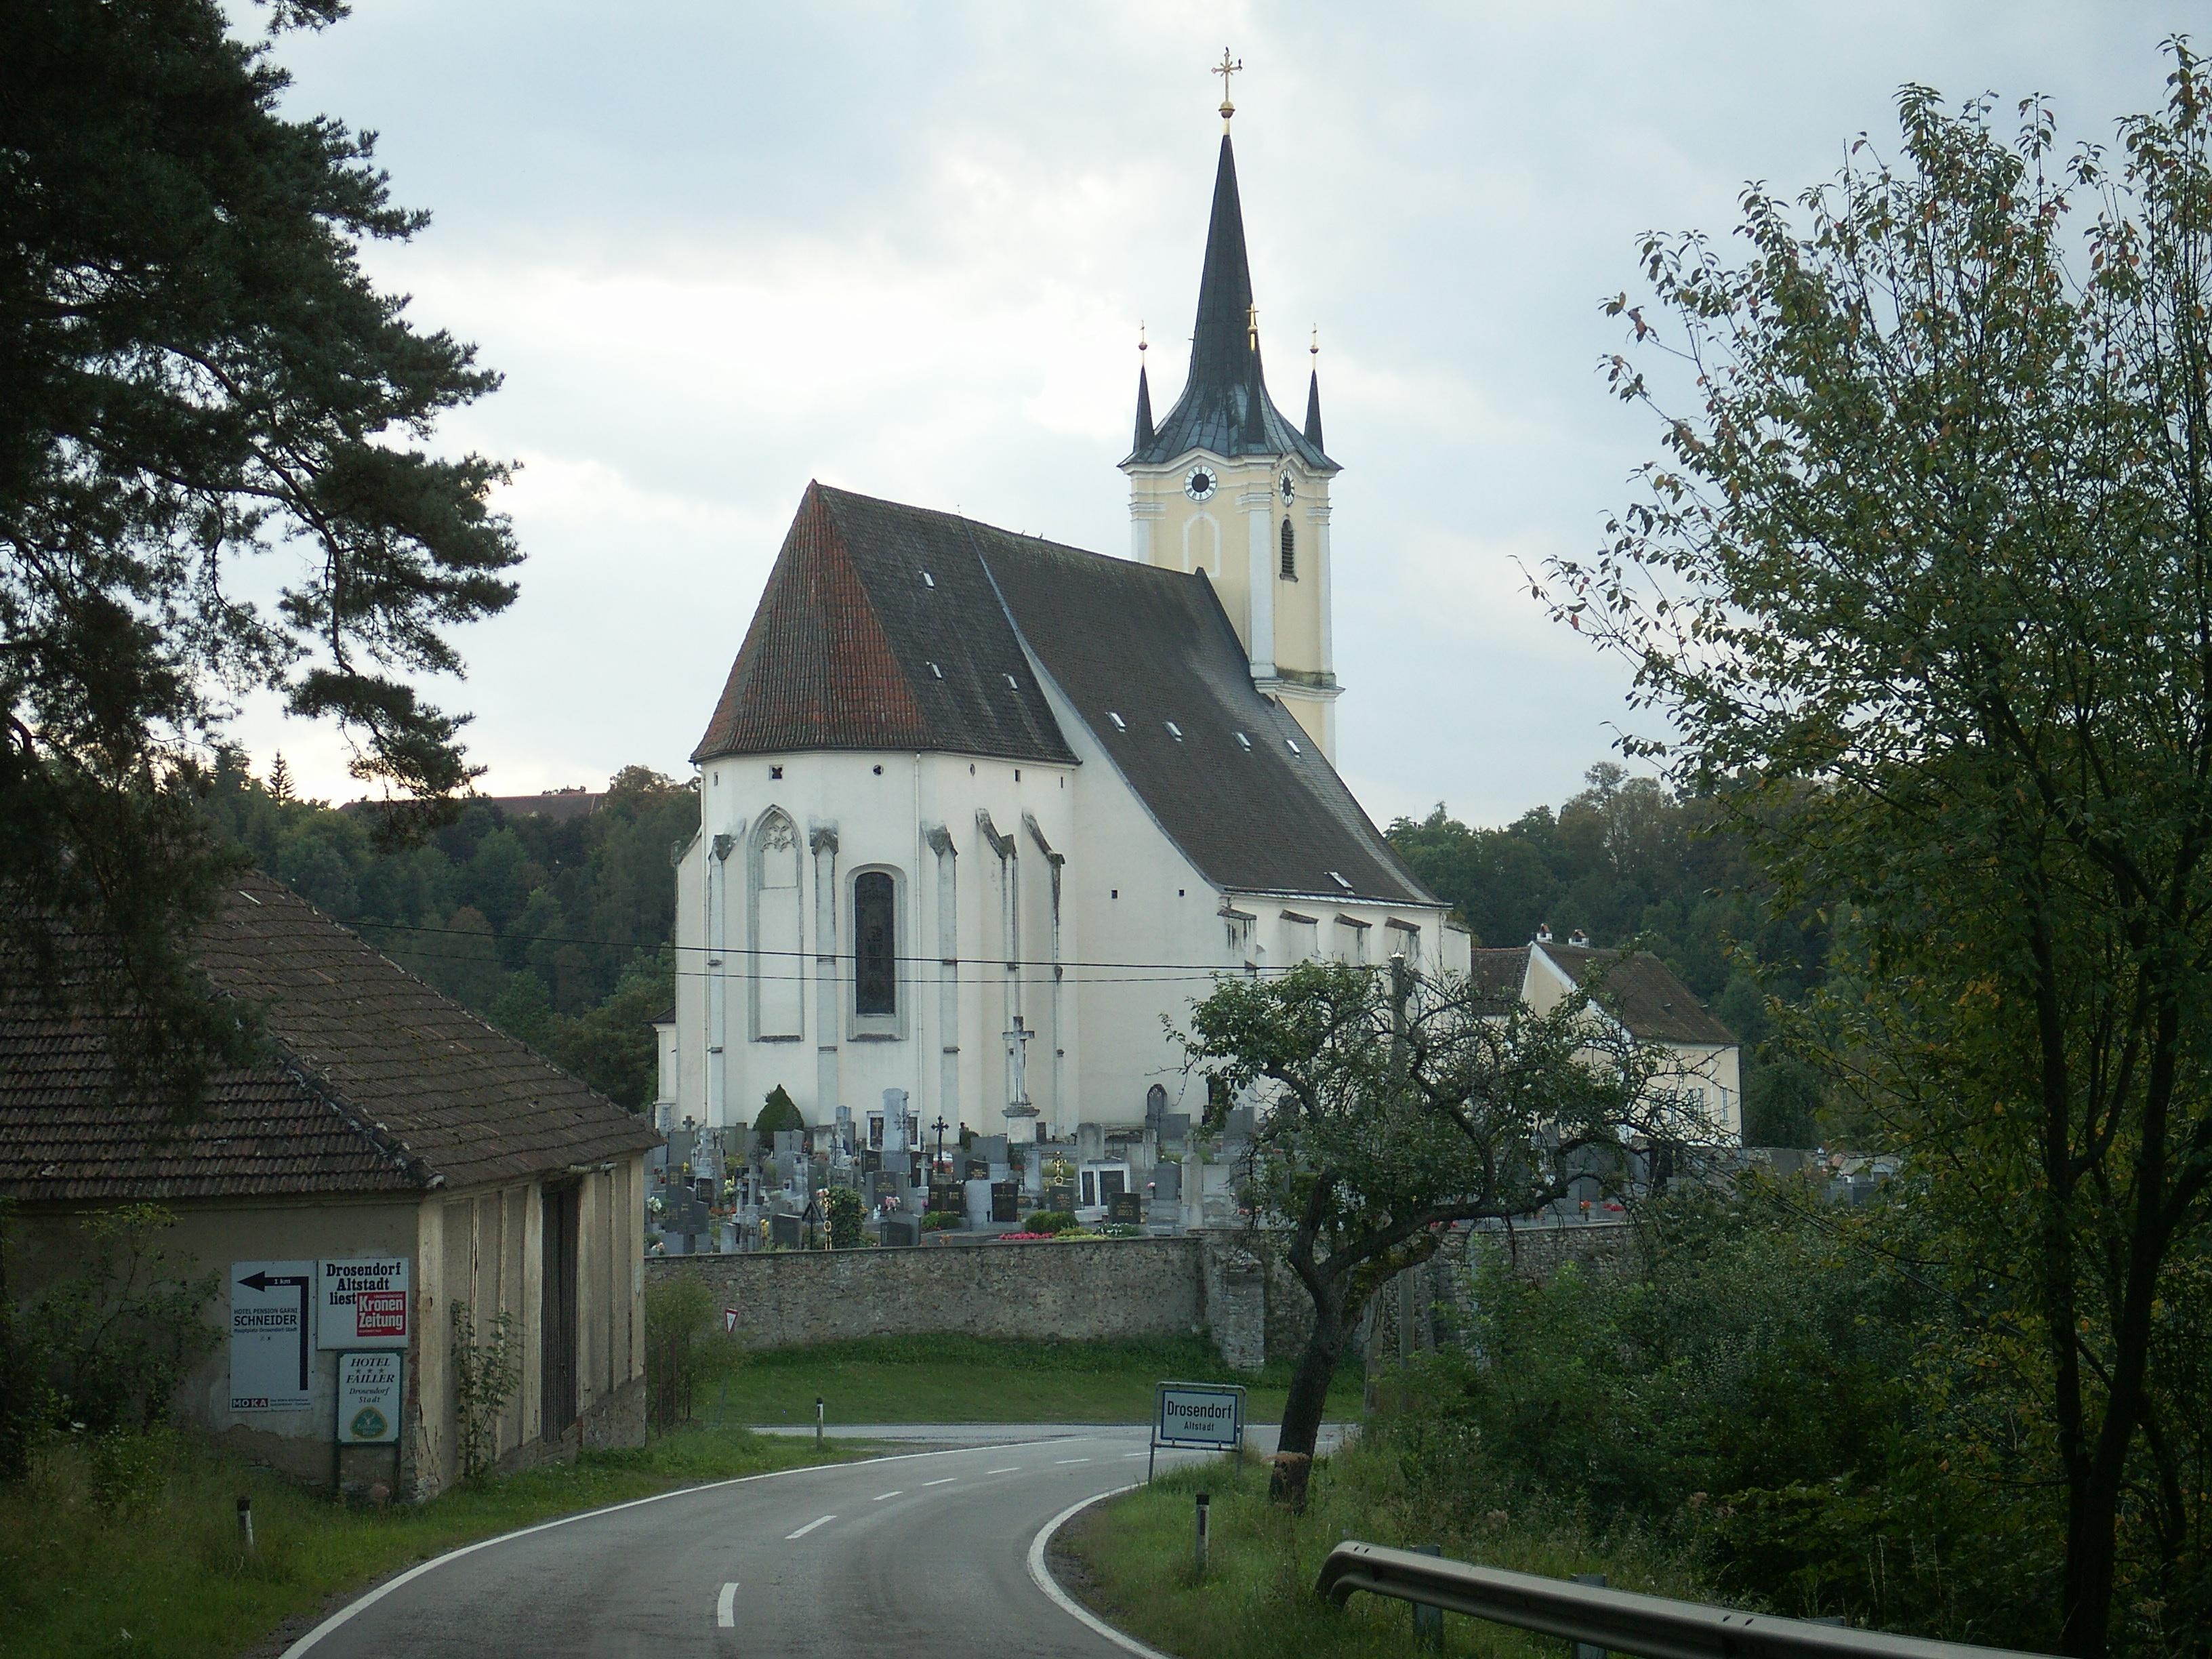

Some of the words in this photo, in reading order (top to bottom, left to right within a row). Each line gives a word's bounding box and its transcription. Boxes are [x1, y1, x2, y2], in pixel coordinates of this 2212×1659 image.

[326, 1263, 401, 1277] Drosendorf
[337, 1277, 389, 1291] Altstadt
[329, 1292, 356, 1305] liest
[359, 1295, 403, 1311] Kronen
[234, 1315, 297, 1326] SCHNEIDER
[359, 1312, 403, 1330] Zeitung
[350, 1358, 390, 1367] HOTEL
[346, 1374, 395, 1383] FAILLER
[349, 1387, 390, 1396] Drosendorf
[232, 1399, 267, 1407] MOKA
[1167, 1401, 1232, 1419] Drosendorf
[1184, 1421, 1214, 1432] Altstadt
